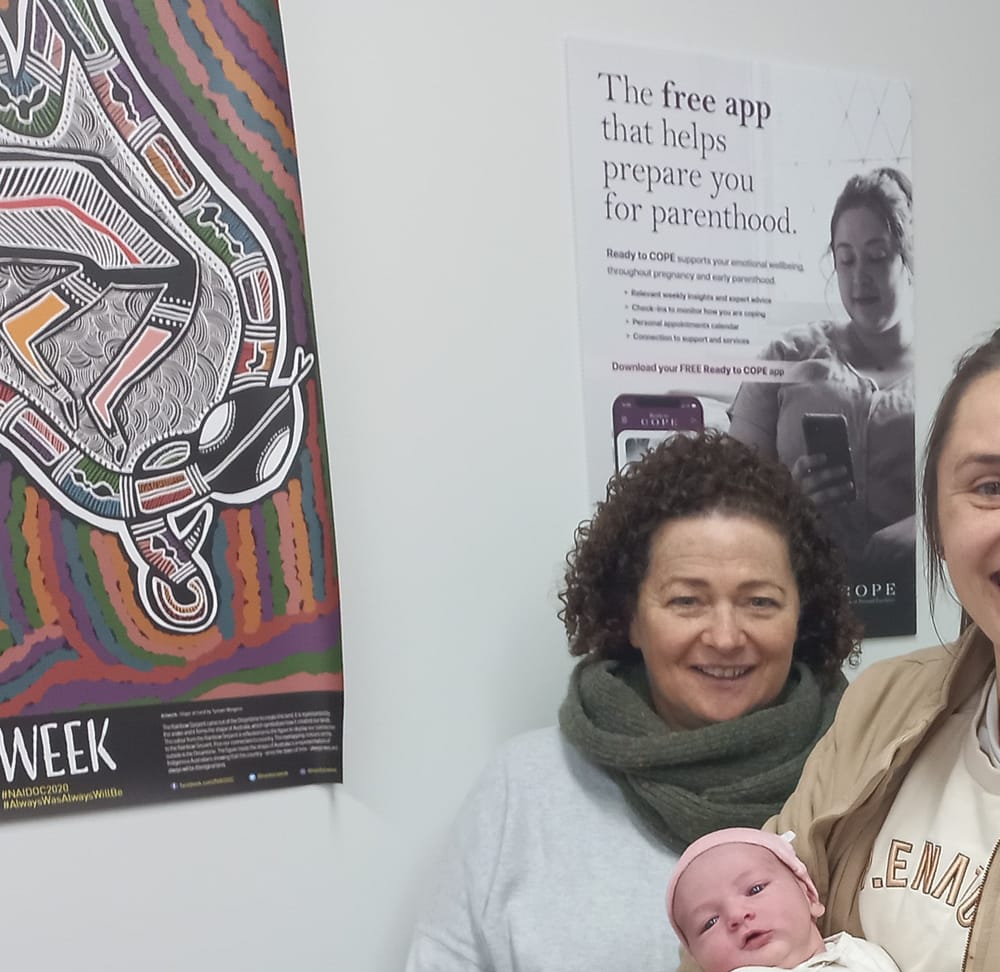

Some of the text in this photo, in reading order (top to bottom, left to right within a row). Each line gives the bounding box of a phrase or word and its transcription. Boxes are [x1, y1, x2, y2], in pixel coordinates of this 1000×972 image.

[598, 72, 772, 129] The free app
[601, 112, 727, 160] that helps
[603, 160, 755, 200] prepare you
[604, 191, 797, 234] for parenthood.
[606, 248, 636, 265] Ready
[637, 250, 648, 260] to
[649, 252, 676, 263] COPE
[677, 255, 711, 266] supports
[712, 258, 729, 267] your
[731, 257, 767, 269] emotional
[607, 266, 652, 278] throughout
[653, 271, 695, 282] pregnancy
[696, 272, 711, 281] and
[712, 272, 730, 283] early
[631, 288, 772, 304] Relevant weekly insights and expert advice
[676, 306, 702, 315] monitor
[703, 307, 718, 316] how
[719, 309, 733, 317] you
[744, 310, 766, 319] coping
[632, 318, 739, 331] Personal appointments calendar
[633, 332, 673, 342] Connection
[682, 336, 708, 345] support
[709, 336, 722, 344] and
[723, 337, 750, 345] services
[611, 361, 785, 377] Download your FREE Ready to COPE app
[0, 717, 117, 782] WEEK
[1, 783, 69, 800] #NAIDOC2020
